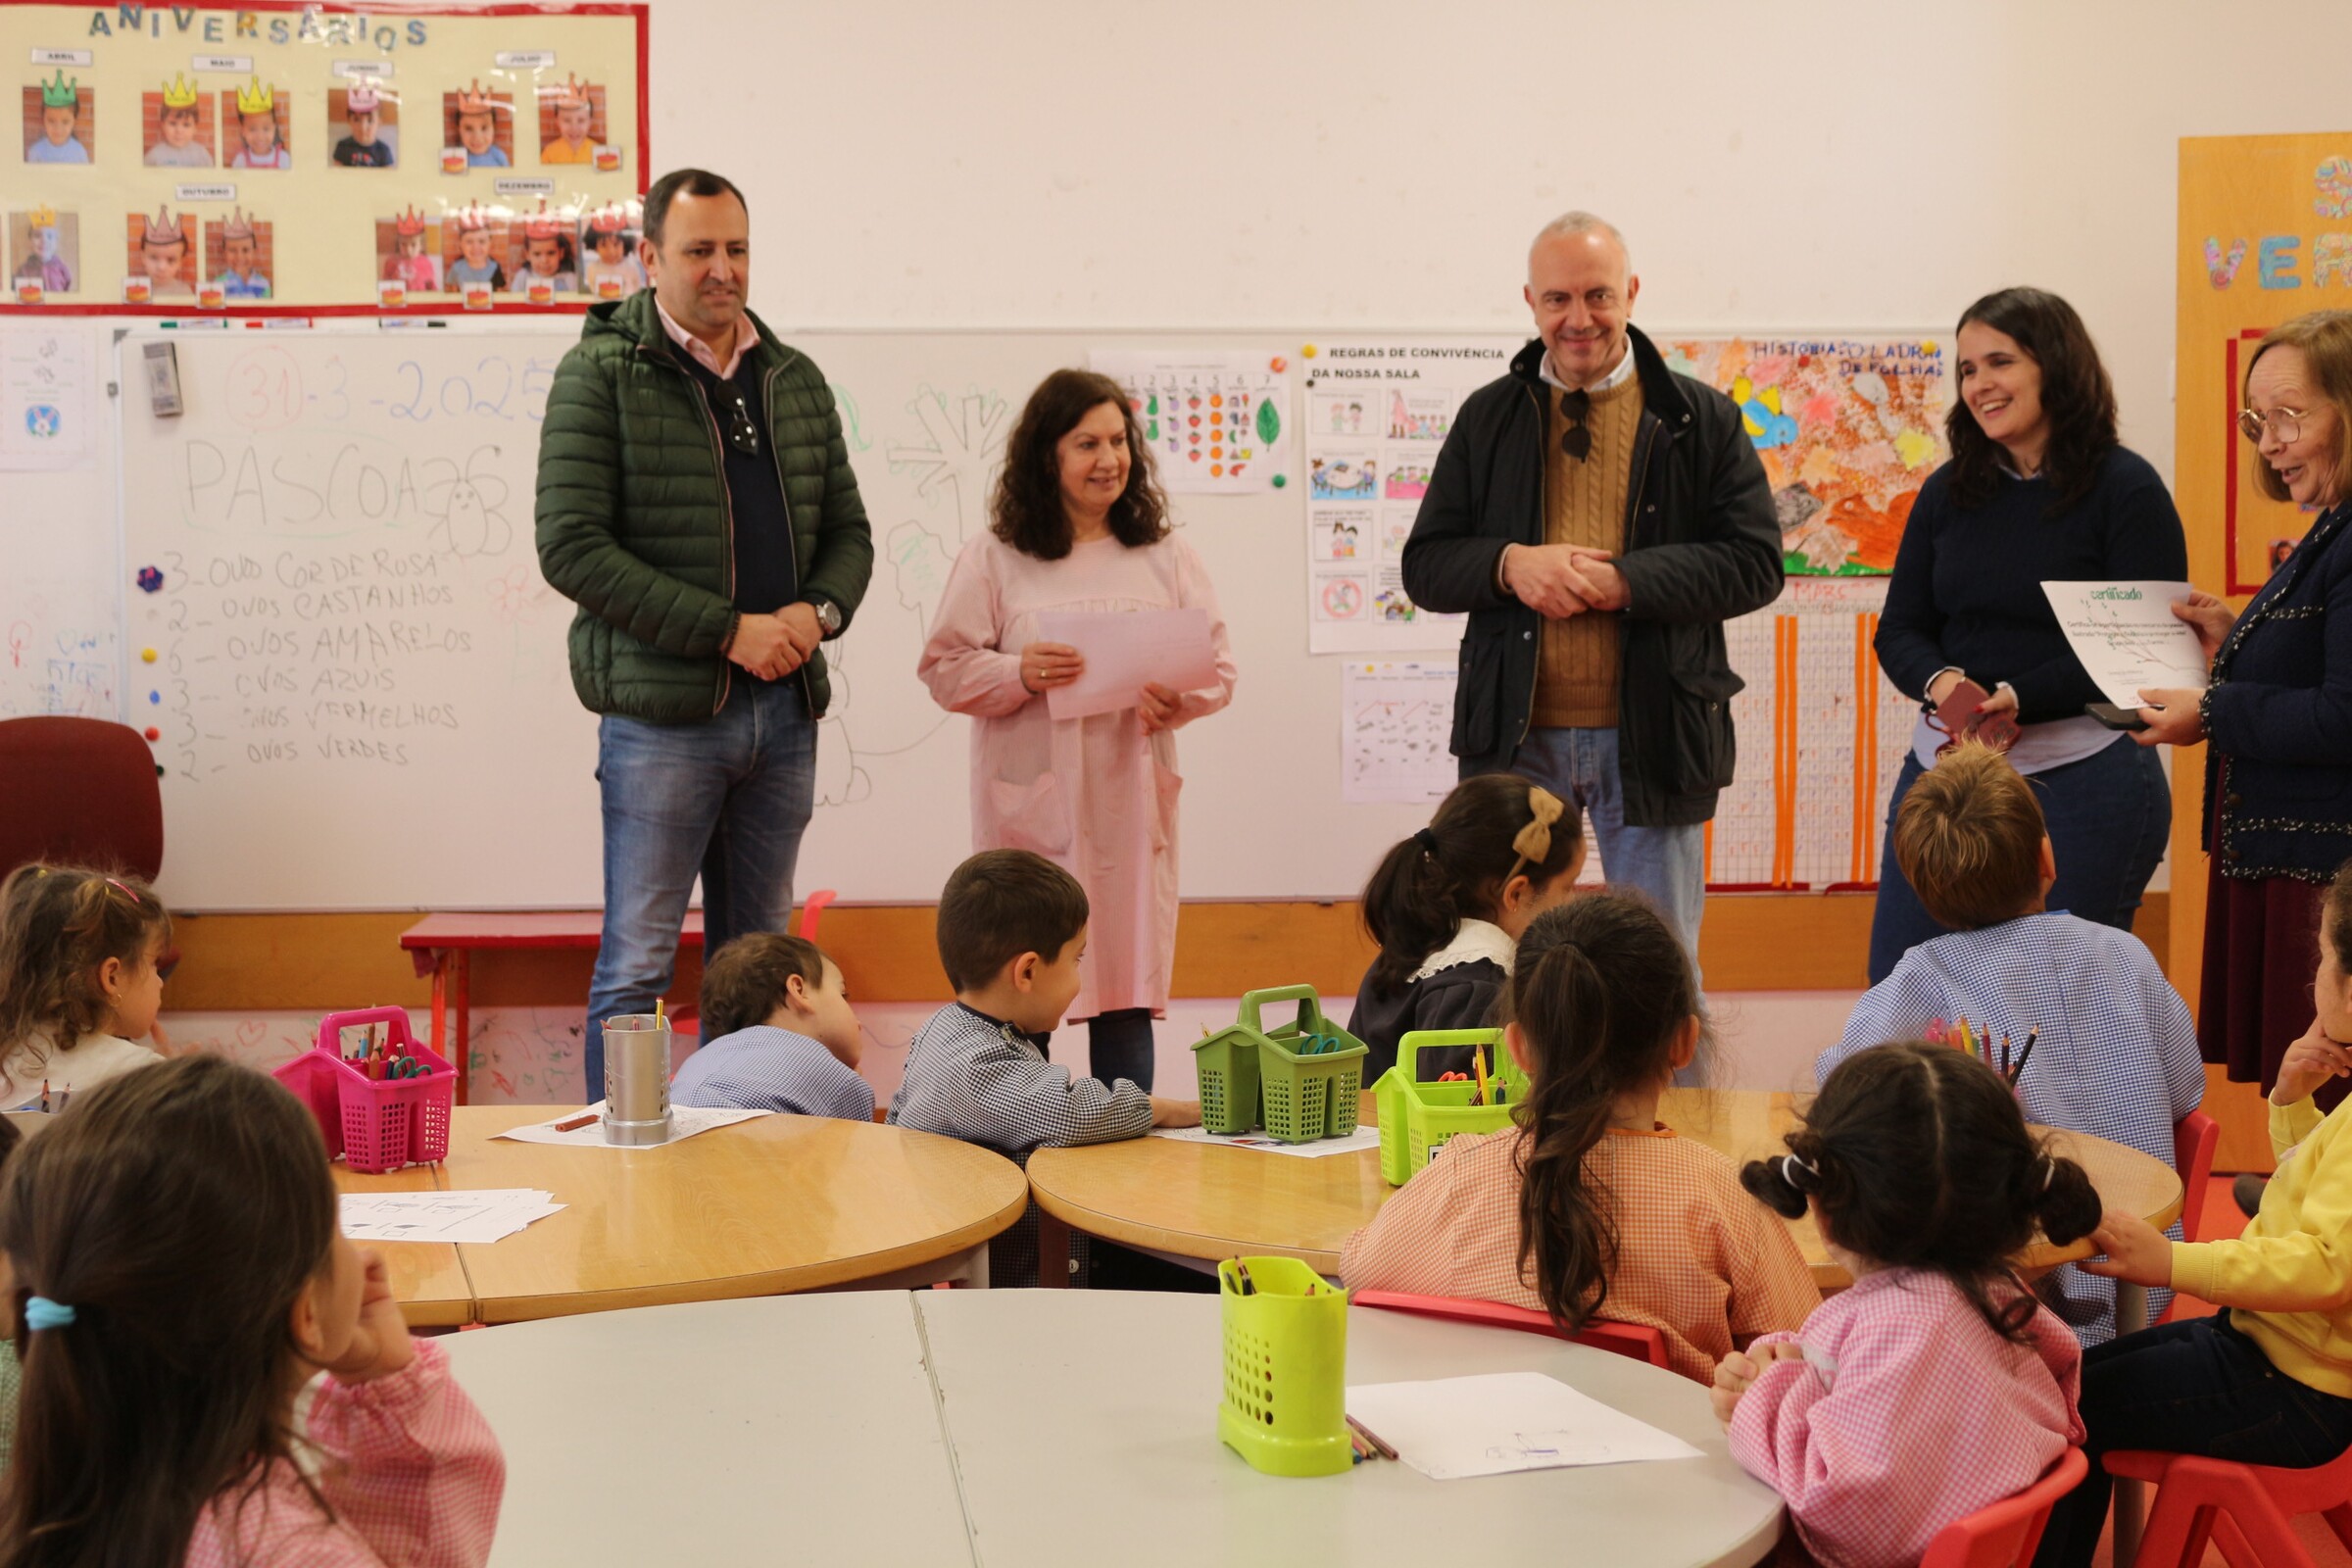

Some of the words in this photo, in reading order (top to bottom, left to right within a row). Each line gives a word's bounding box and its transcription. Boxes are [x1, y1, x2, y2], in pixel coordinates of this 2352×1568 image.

[1330, 347, 1385, 359] REGRAS
[1390, 347, 1407, 358] DE
[1411, 346, 1505, 360] CONVIVÊNCIA
[1311, 368, 1330, 378] DA
[1335, 368, 1382, 379] NOSSA
[1386, 368, 1421, 379] SALA
[221, 596, 281, 619] OVOS
[293, 583, 455, 621] CASTANHOS
[2089, 587, 2142, 601] certificado
[226, 625, 301, 662] OVOS
[310, 621, 472, 667] AMARELOS
[310, 667, 396, 697] AZUIS
[304, 699, 460, 731] VERMELHOS
[246, 738, 299, 764] OVOS
[316, 733, 410, 766] VERDES
